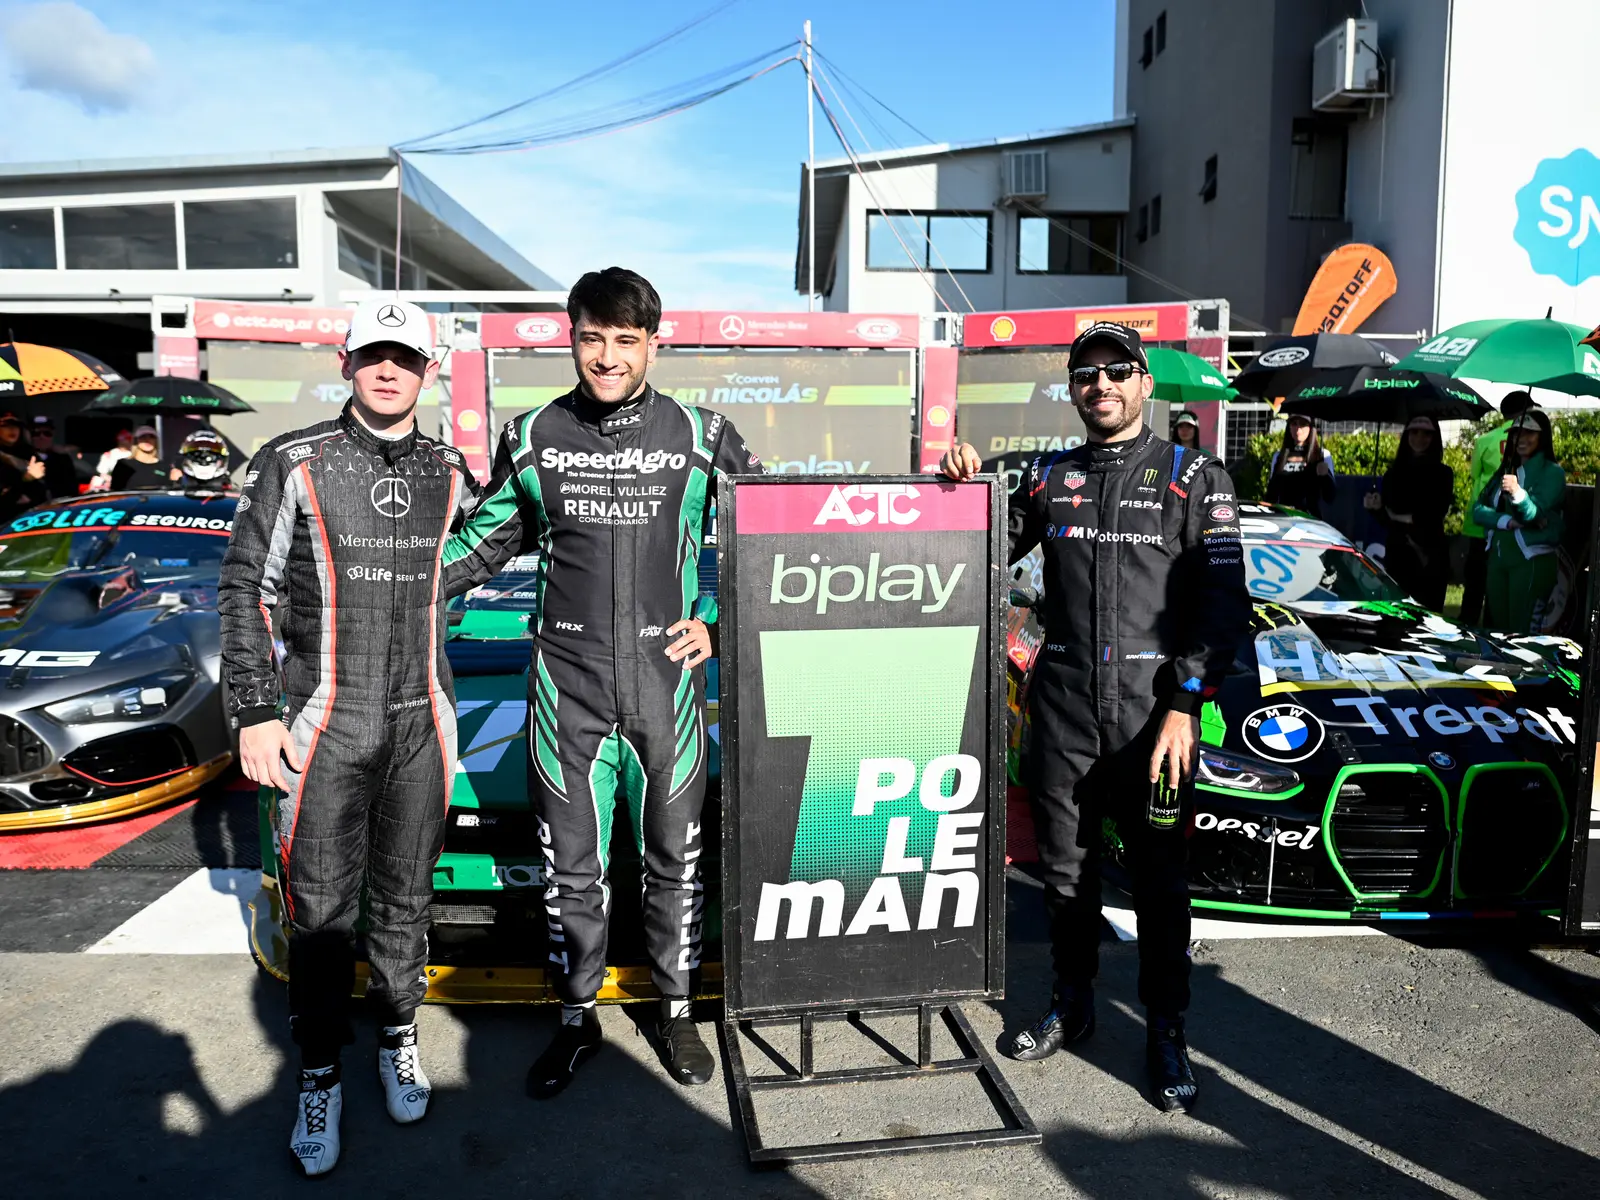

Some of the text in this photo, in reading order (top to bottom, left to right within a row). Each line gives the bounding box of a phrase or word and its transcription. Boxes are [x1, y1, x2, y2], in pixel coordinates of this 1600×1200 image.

[606, 412, 644, 428] HRX
[706, 412, 722, 442] HRX
[288, 446, 314, 460] OMP
[540, 446, 687, 475] SpeedAgro
[1067, 472, 1085, 480] TAG
[1181, 454, 1208, 485] HRX
[571, 484, 667, 497] MOREL VULLIEZ
[1203, 493, 1233, 504] HRX
[564, 500, 662, 518] RENAULT
[813, 484, 922, 526] ACTC
[1120, 500, 1164, 510] FISPA
[578, 516, 649, 526] CONCESONARIOS
[1086, 527, 1163, 546] Motorsport
[364, 568, 393, 581] Life
[555, 620, 584, 632] HRX
[1250, 707, 1305, 730] BMW
[1331, 696, 1577, 744] Trepat
